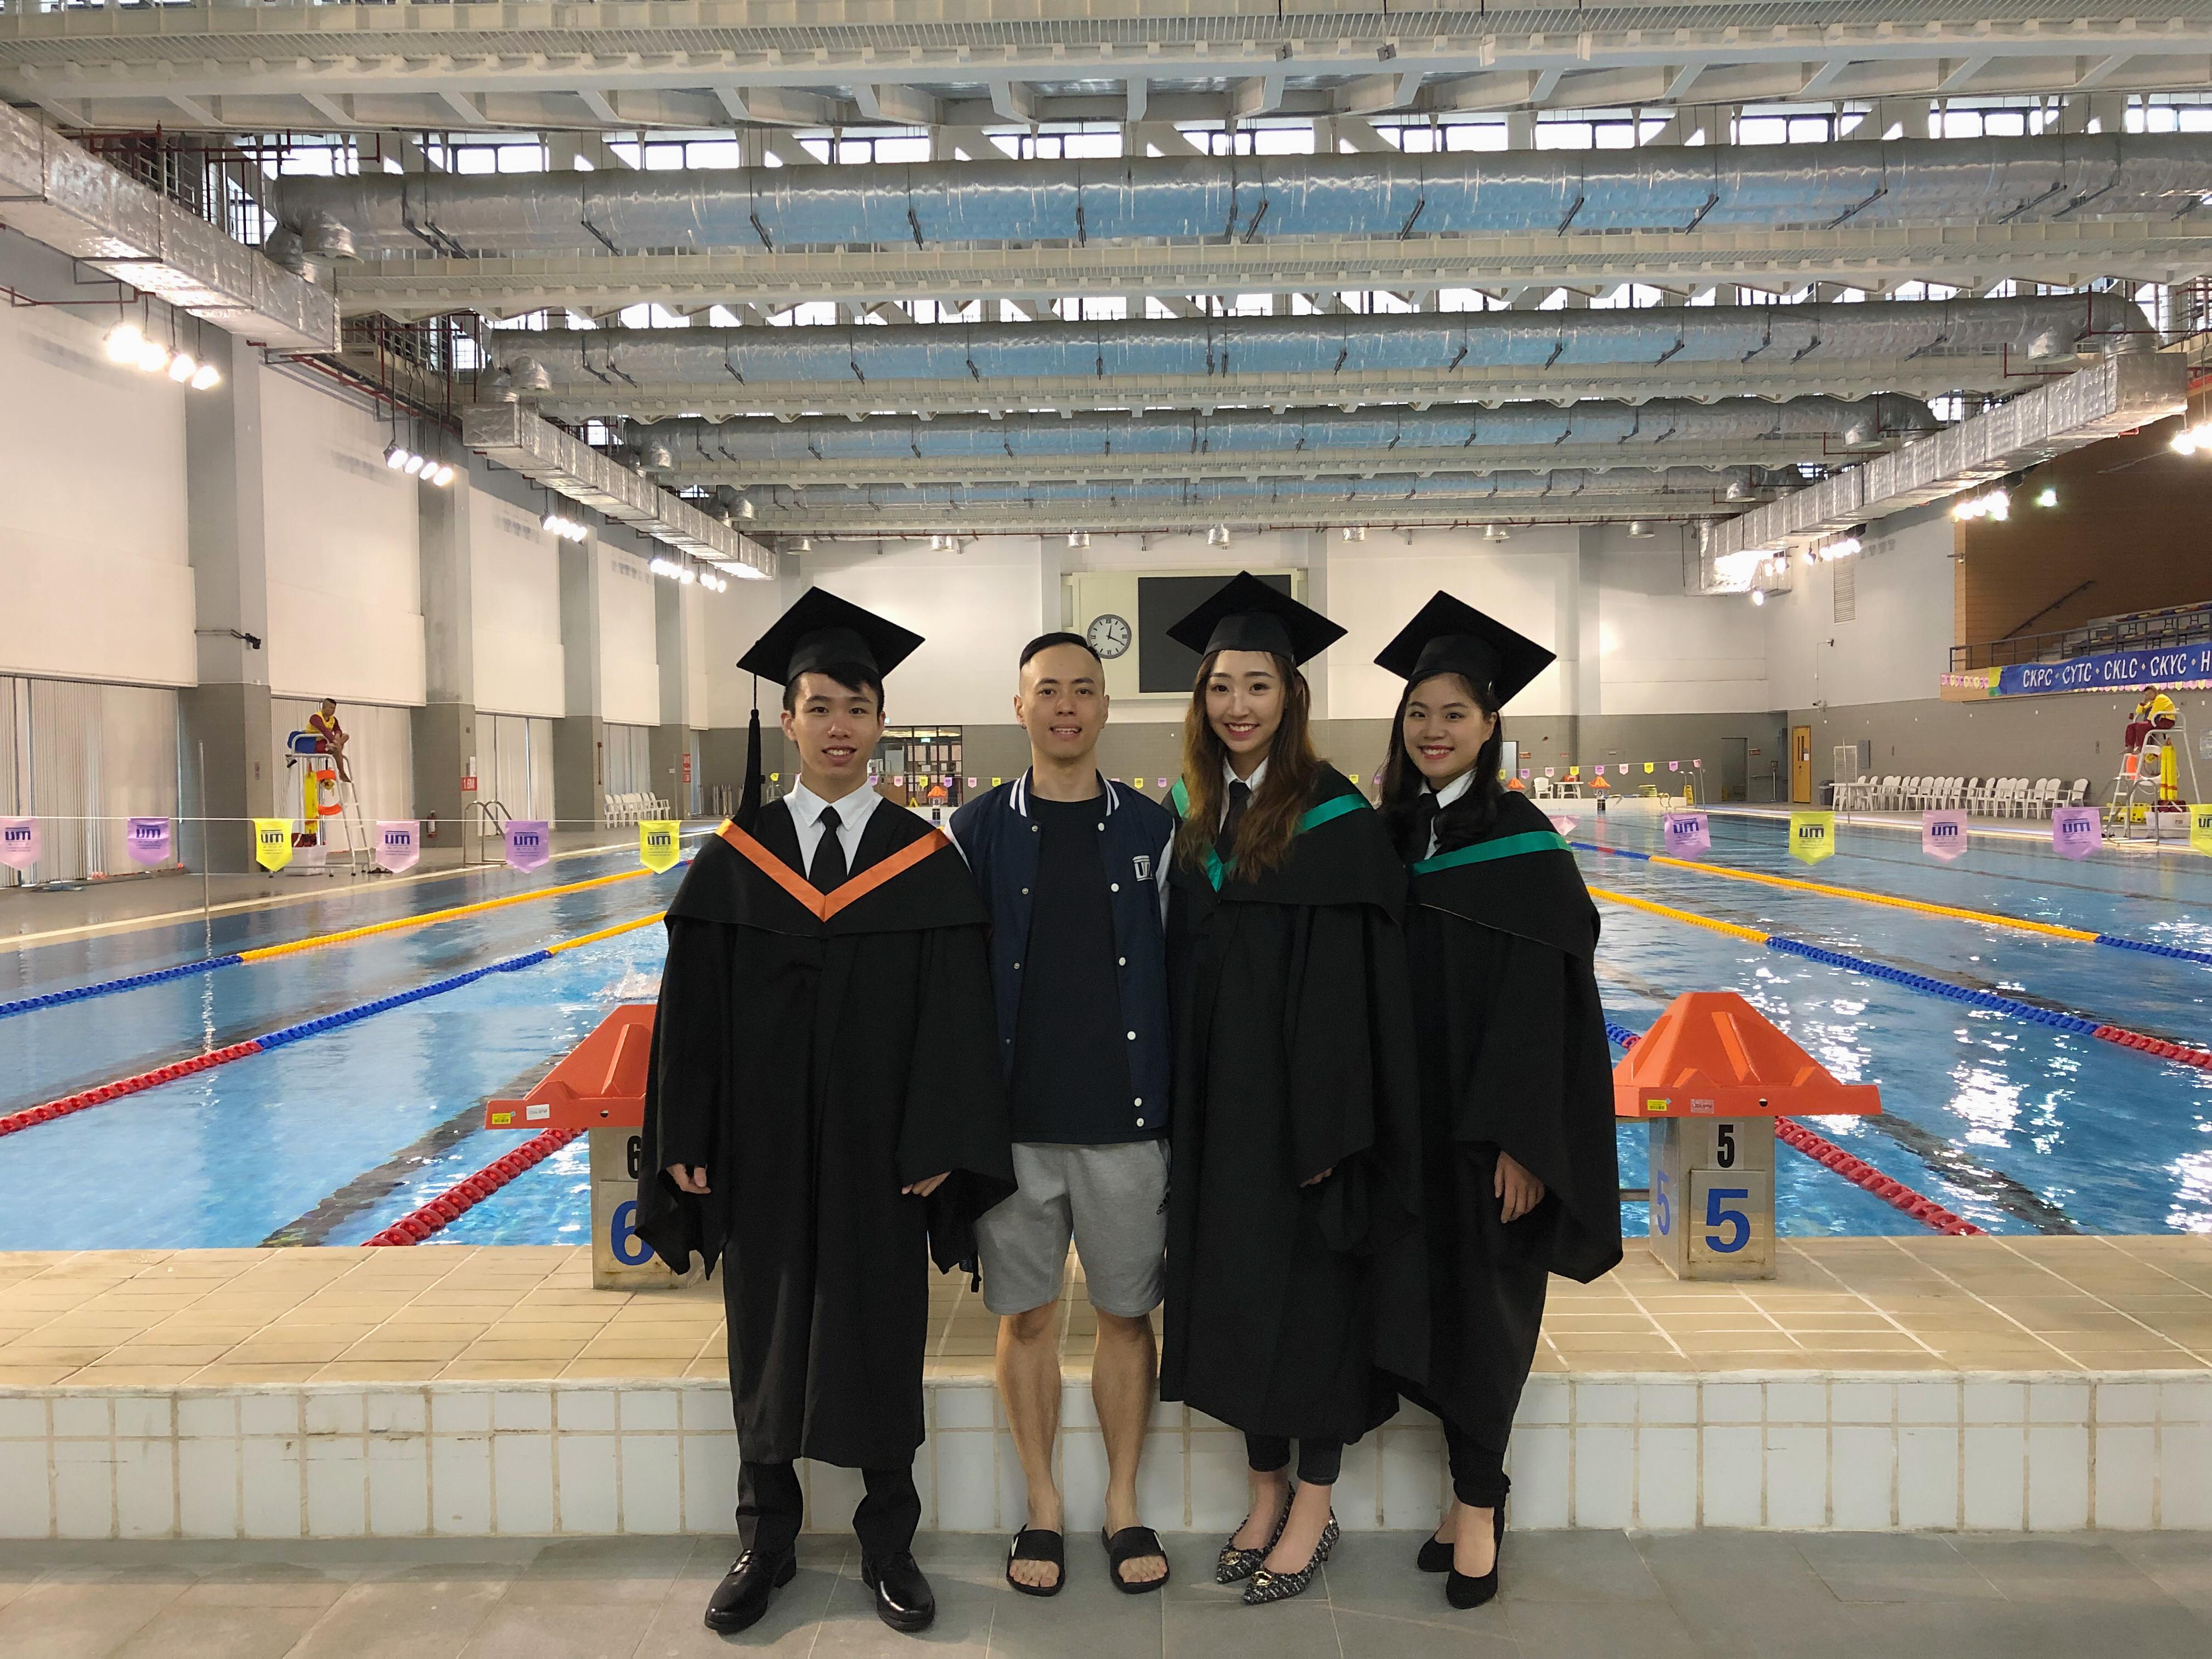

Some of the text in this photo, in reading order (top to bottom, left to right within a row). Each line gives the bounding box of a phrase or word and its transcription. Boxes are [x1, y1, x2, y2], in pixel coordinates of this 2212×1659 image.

[2023, 669, 2053, 687] CKPC
[2062, 663, 2092, 684] CYTC
[2104, 658, 2137, 680] CKLC
[2149, 653, 2187, 676] CKYC
[627, 1135, 642, 1180] 6
[1717, 1124, 1735, 1169] 5
[1657, 1170, 1671, 1236] 5
[1705, 1188, 1751, 1254] 5
[611, 1200, 656, 1266] 6
